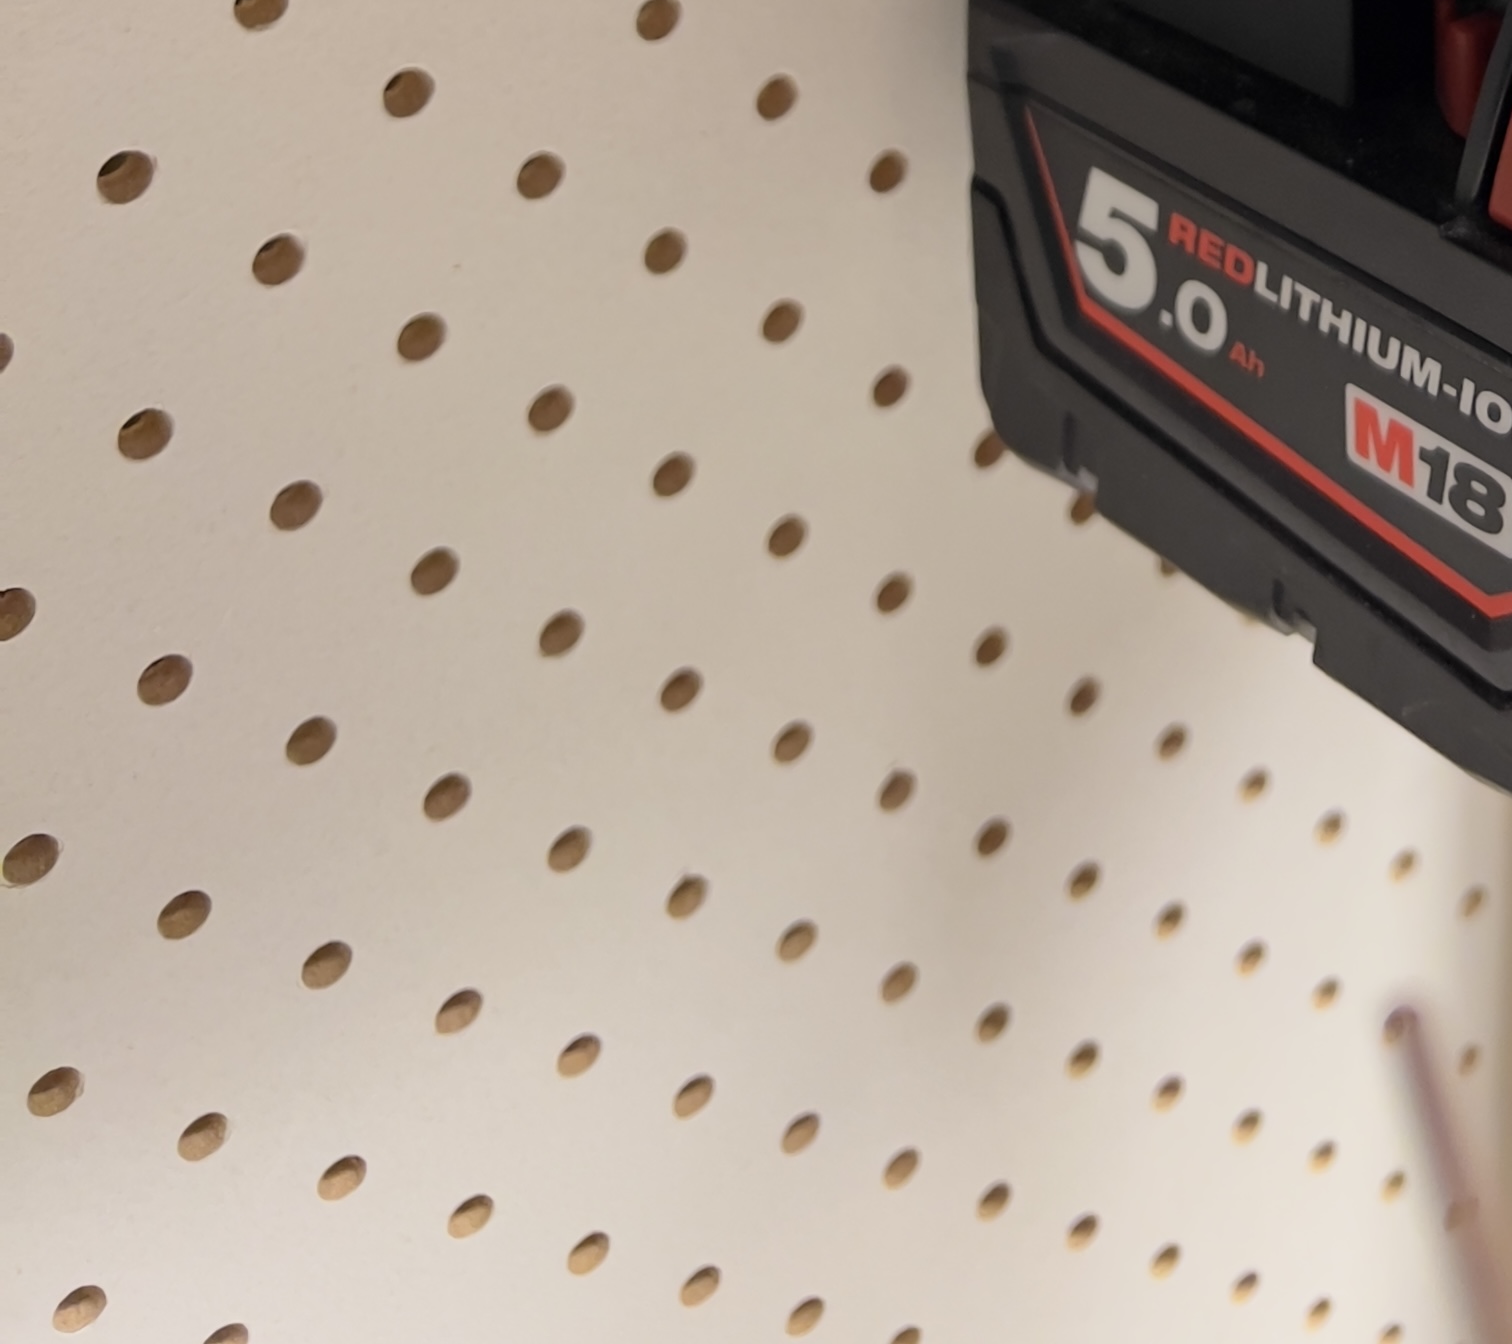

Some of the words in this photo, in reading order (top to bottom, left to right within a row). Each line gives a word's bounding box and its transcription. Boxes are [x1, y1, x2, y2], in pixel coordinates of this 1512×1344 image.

[1074, 165, 1228, 352] 5.0
[1228, 340, 1266, 380] Ah
[1352, 397, 1507, 535] M18
